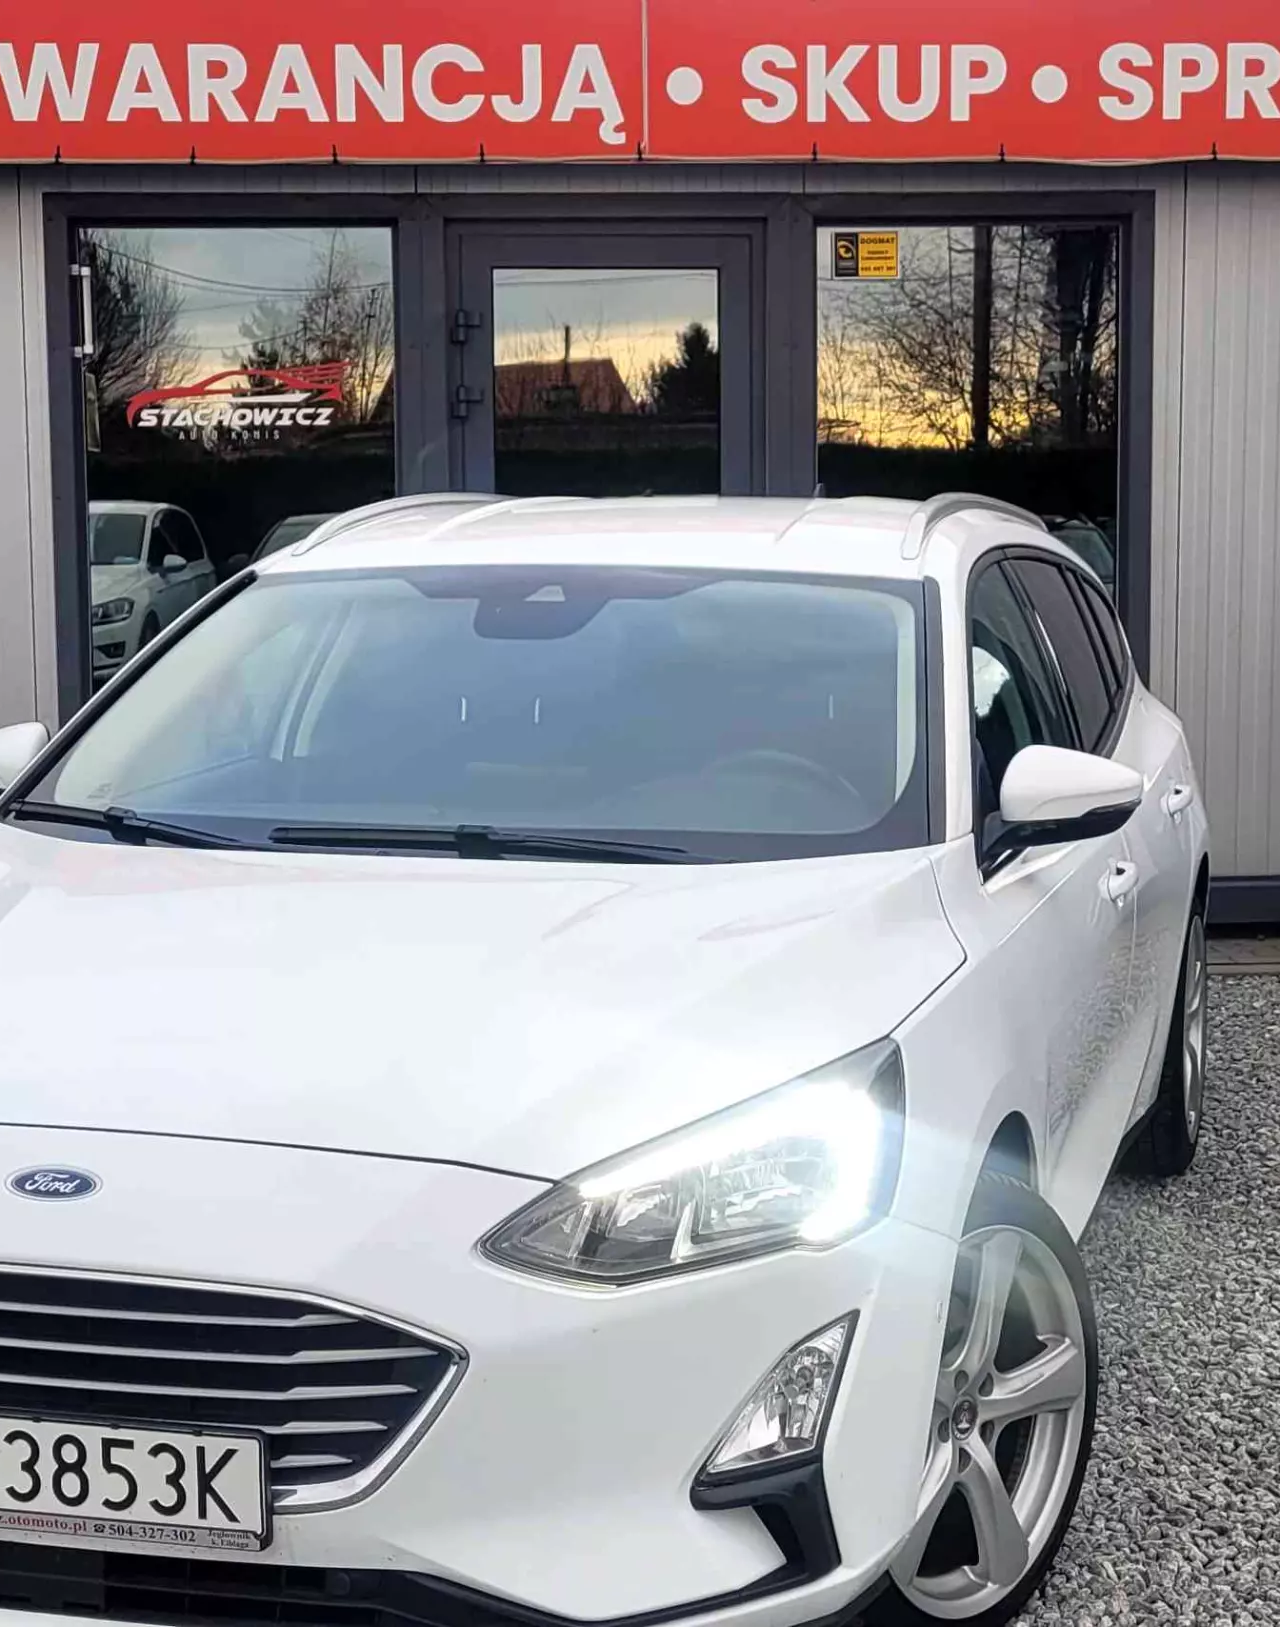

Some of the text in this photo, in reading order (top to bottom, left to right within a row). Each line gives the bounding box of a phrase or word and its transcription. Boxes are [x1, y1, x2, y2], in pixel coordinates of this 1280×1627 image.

[741, 43, 1007, 124] SKUP
[137, 407, 335, 427] STACHOWICZ
[179, 429, 280, 441] AUTO KOMIS
[24, 1172, 81, 1193] Ford
[3, 1429, 242, 1524] 3853K
[108, 1523, 197, 1543] 504-327-302
